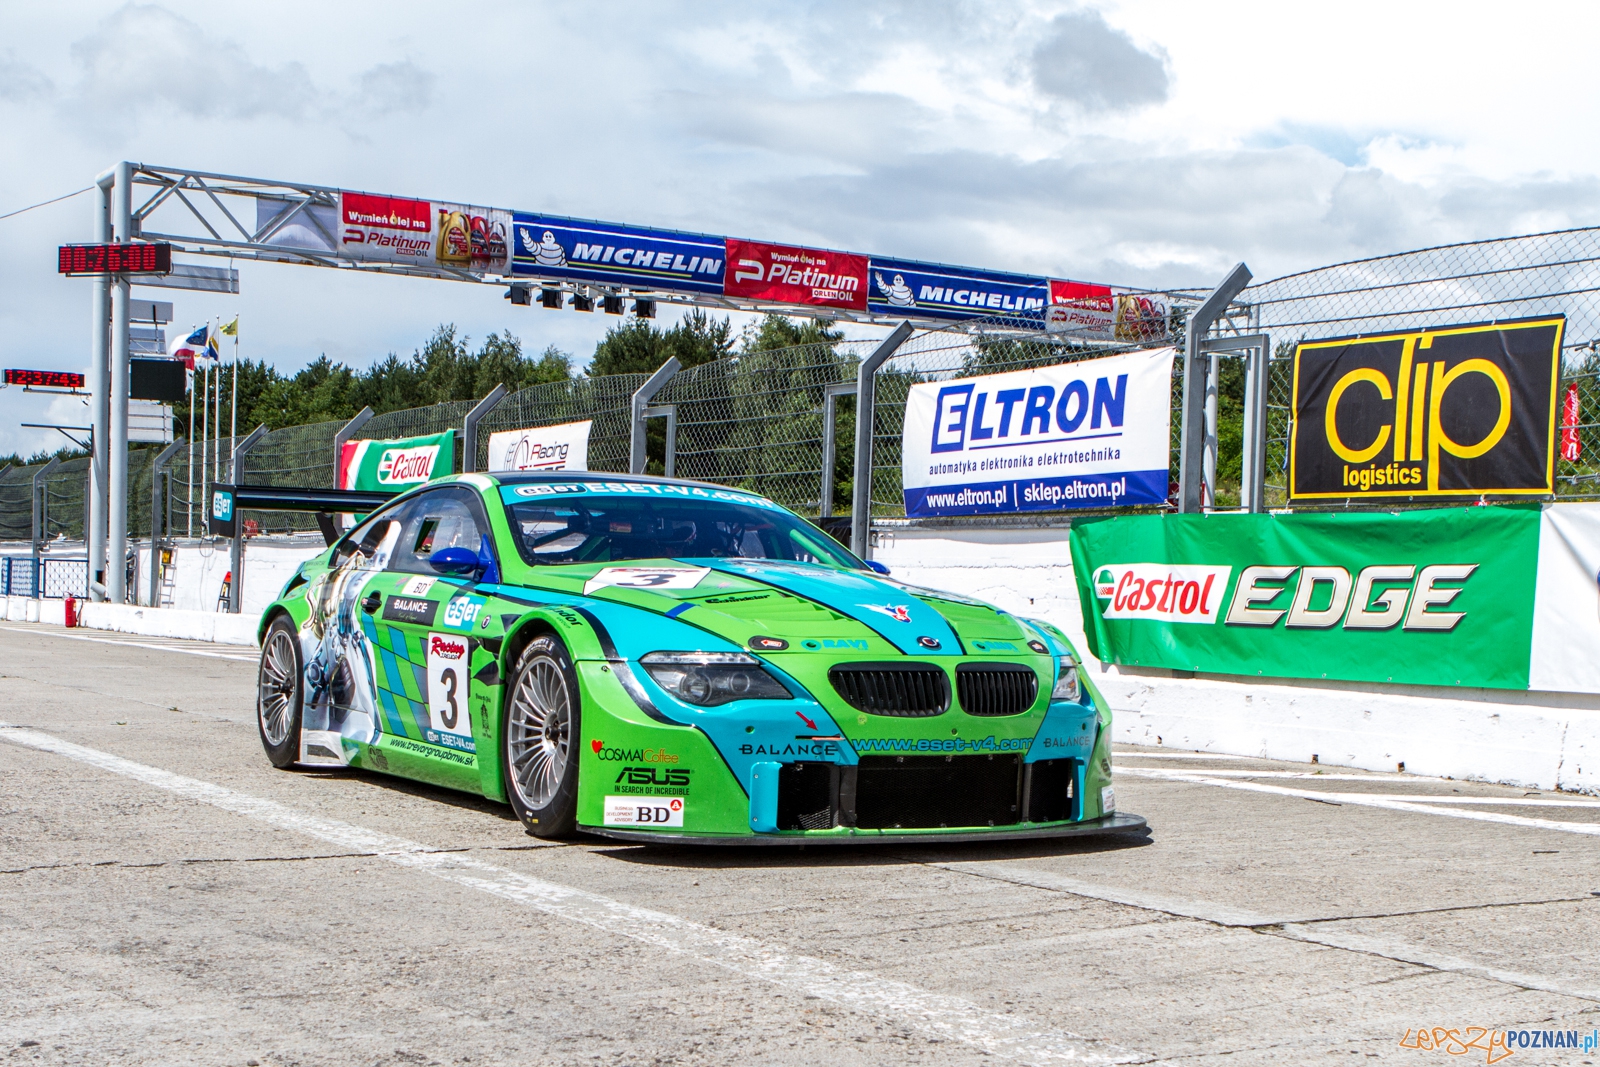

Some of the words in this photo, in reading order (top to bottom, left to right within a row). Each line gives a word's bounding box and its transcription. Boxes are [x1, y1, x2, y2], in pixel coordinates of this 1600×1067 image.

[348, 211, 388, 224] Wymień
[413, 220, 425, 228] na
[366, 231, 431, 251] Platinum
[416, 249, 428, 257] OIL
[572, 243, 722, 275] MICHELIN
[767, 263, 858, 291] Platinum
[813, 290, 836, 299] ORLEN
[838, 291, 853, 302] OIL
[919, 285, 1043, 312] MICHELIN
[6, 369, 80, 387] 12:37:43
[931, 374, 1128, 454] ELTRON
[1325, 336, 1511, 490] clip
[530, 441, 569, 460] Racing
[392, 451, 433, 480] Castrol
[929, 459, 977, 476] automatyka
[980, 450, 1033, 471] elektronika
[1037, 447, 1121, 466] elektrotechnika
[1343, 462, 1422, 491] logistics
[927, 485, 1007, 508] www.eltron.pl
[1024, 477, 1126, 505] sklep.eltron.pl
[616, 574, 676, 586] 3
[394, 599, 428, 612] BALANCE
[1114, 570, 1215, 616] Castrol
[1224, 564, 1480, 632] EDGE
[431, 636, 465, 660] Racing
[440, 668, 458, 730] 3
[738, 744, 839, 756] BALANCE
[853, 735, 1034, 751] www.eset-v4.com
[1043, 736, 1090, 748] BALANCE
[390, 738, 475, 767] www.trevorgroupbmw.sk
[615, 766, 690, 786] ASUS
[614, 785, 621, 793] IN
[621, 785, 644, 794] SEARCH
[645, 786, 653, 795] OF
[654, 787, 690, 796] INCREDIBLE
[635, 806, 671, 823] BD
